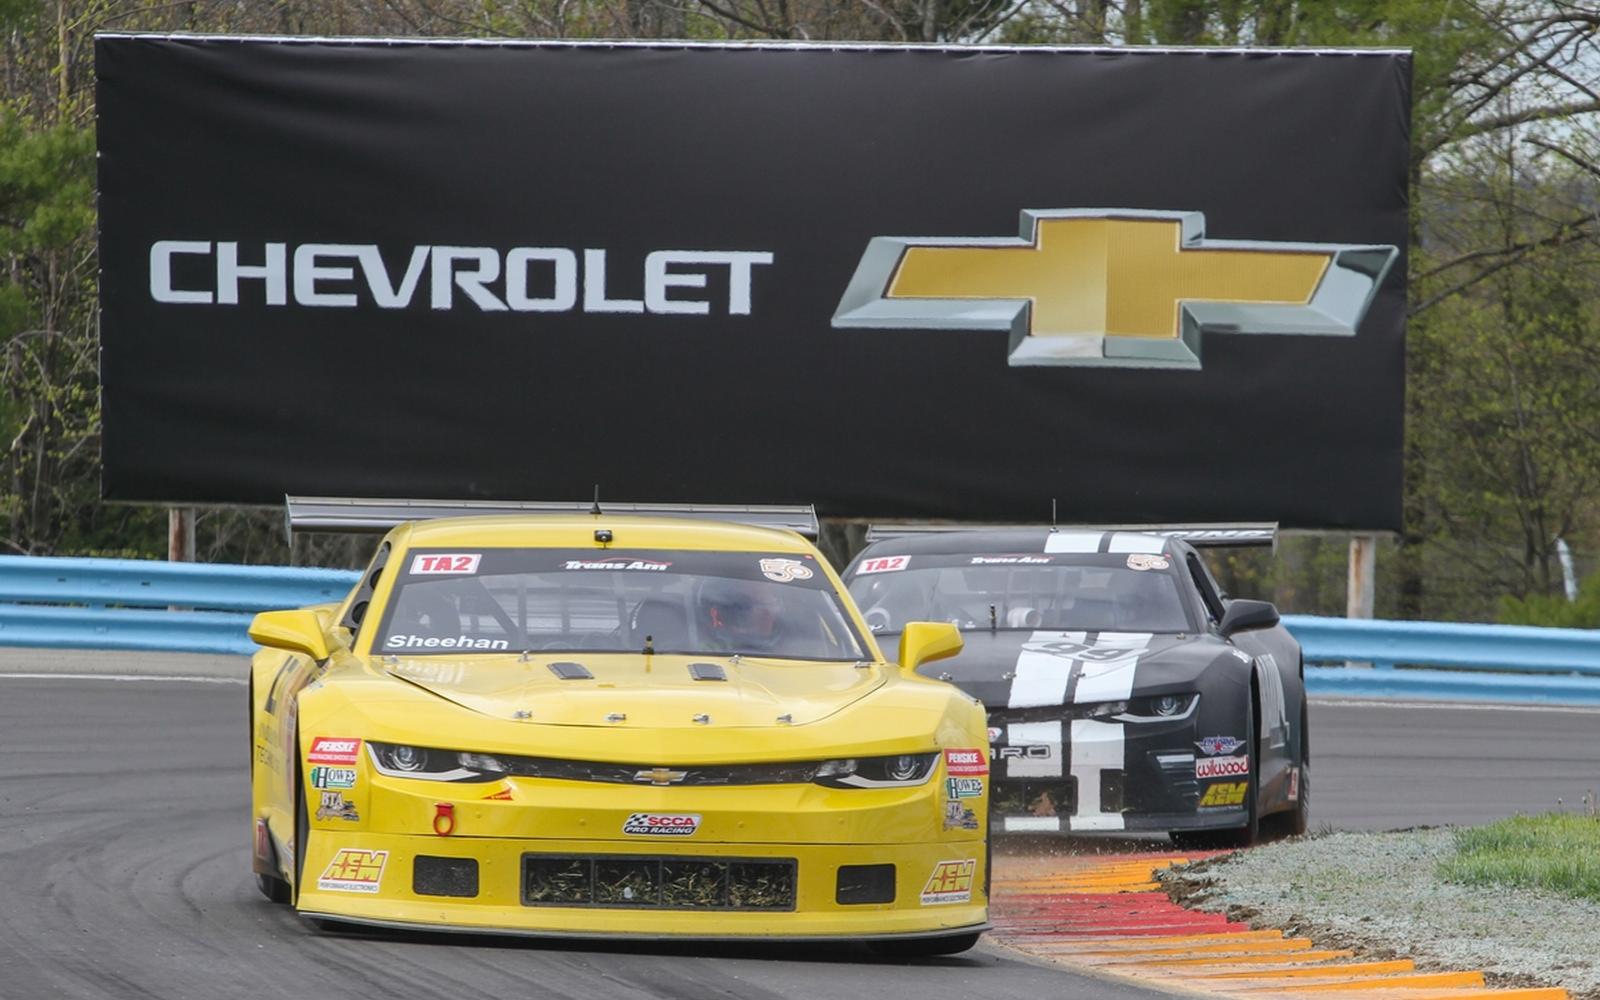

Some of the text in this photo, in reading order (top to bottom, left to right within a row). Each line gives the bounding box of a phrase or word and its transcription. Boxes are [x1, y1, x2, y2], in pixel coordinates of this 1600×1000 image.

[150, 240, 774, 315] CHEVROLET
[421, 556, 473, 572] TA2
[564, 559, 669, 571] Trans Am
[865, 557, 905, 572] TA2
[386, 634, 510, 650] Sheehan
[1198, 755, 1248, 776] wilwood
[647, 816, 695, 826] SCCA
